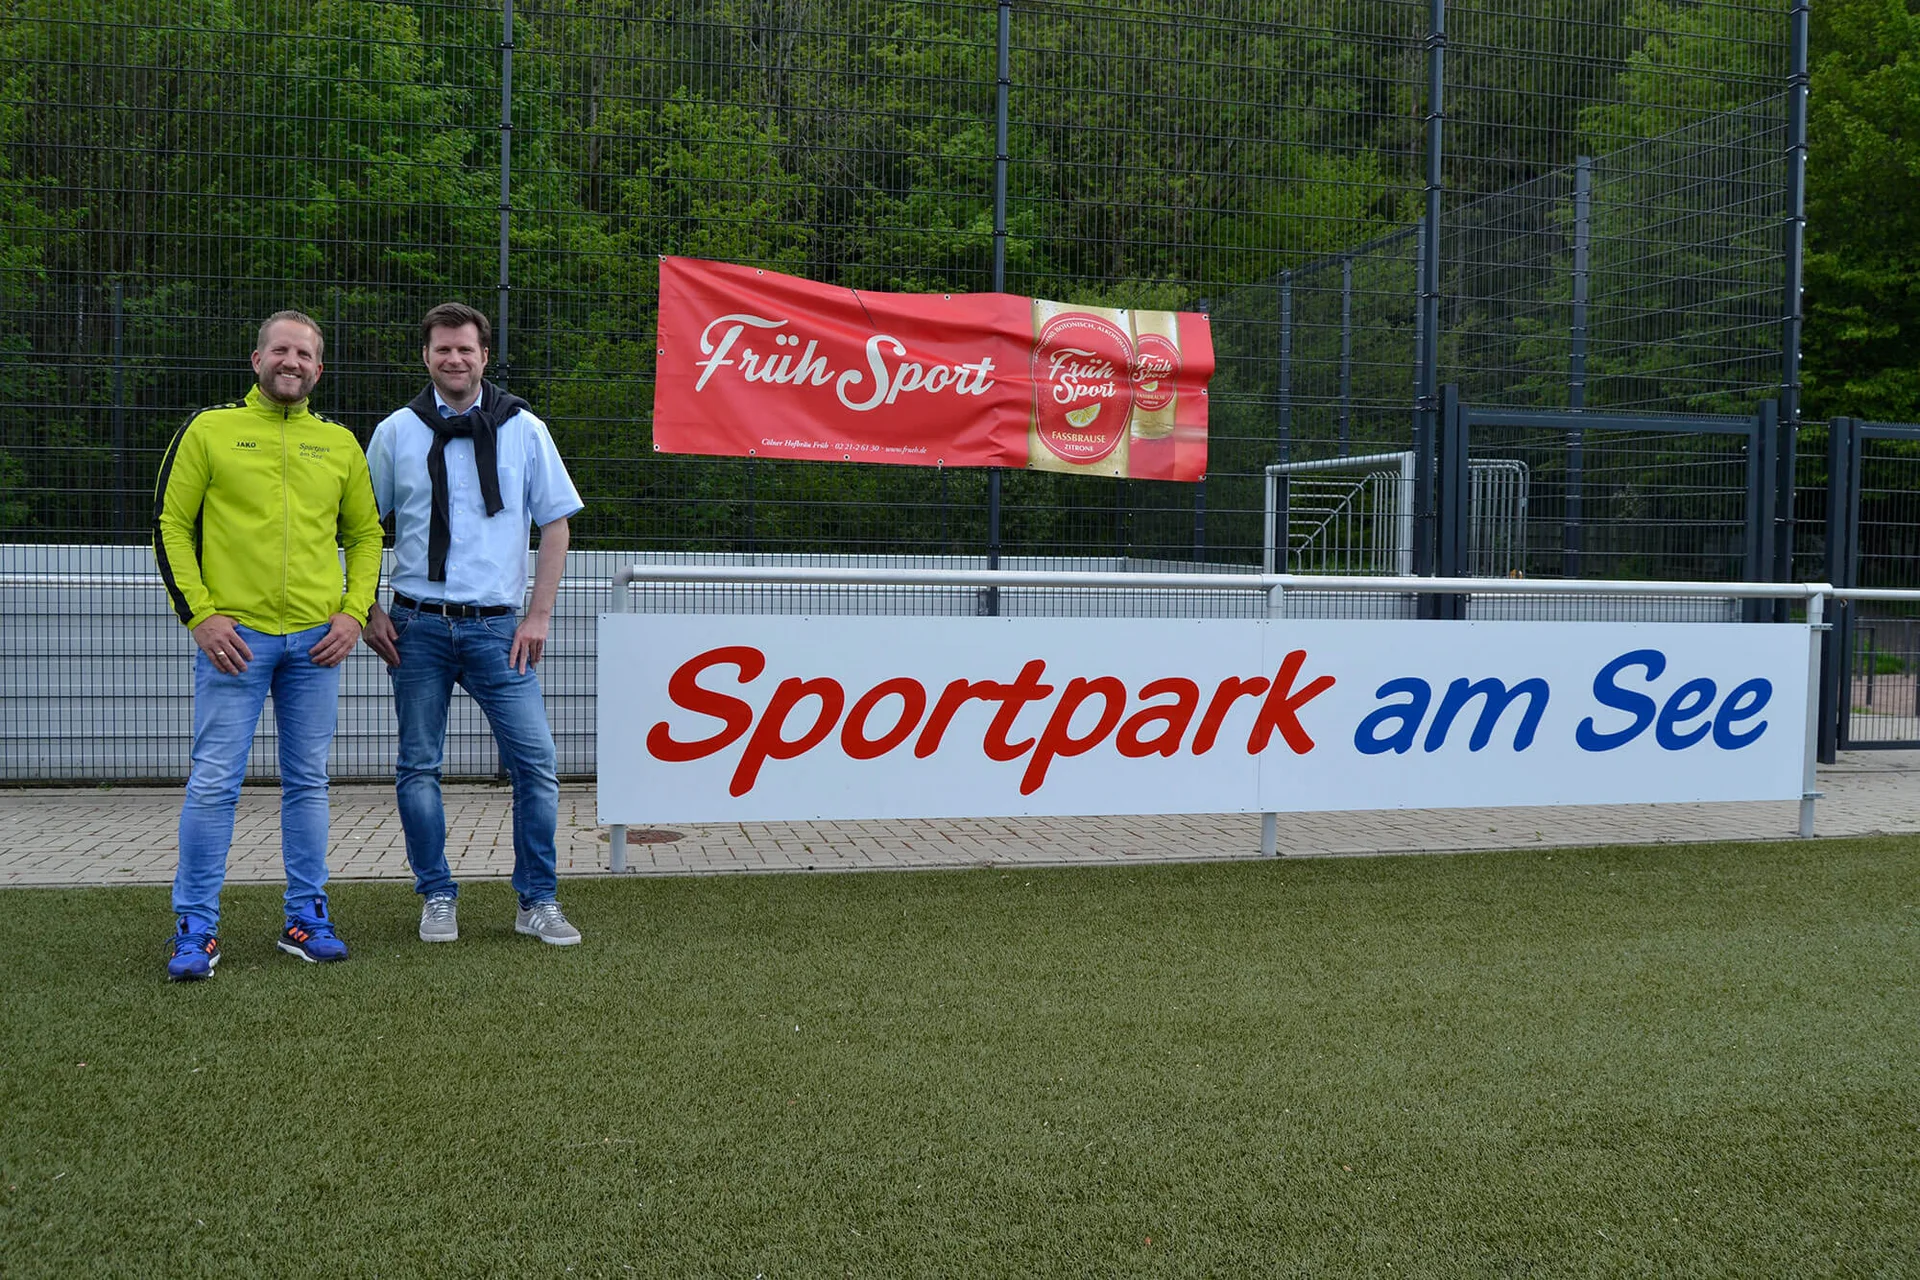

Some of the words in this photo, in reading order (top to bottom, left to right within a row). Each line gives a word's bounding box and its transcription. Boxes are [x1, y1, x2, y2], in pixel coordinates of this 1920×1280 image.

[696, 314, 834, 391] Früh
[836, 335, 996, 411] Sport
[1049, 348, 1116, 381] Früh
[1053, 374, 1117, 404] Sport
[236, 441, 256, 449] JAKO
[812, 441, 829, 450] Früh
[1052, 431, 1106, 444] FASSBRAUSE
[1064, 444, 1094, 452] ZITRONE
[646, 645, 1336, 797] Sportpark
[1354, 678, 1549, 754] am
[1576, 650, 1772, 751] See
